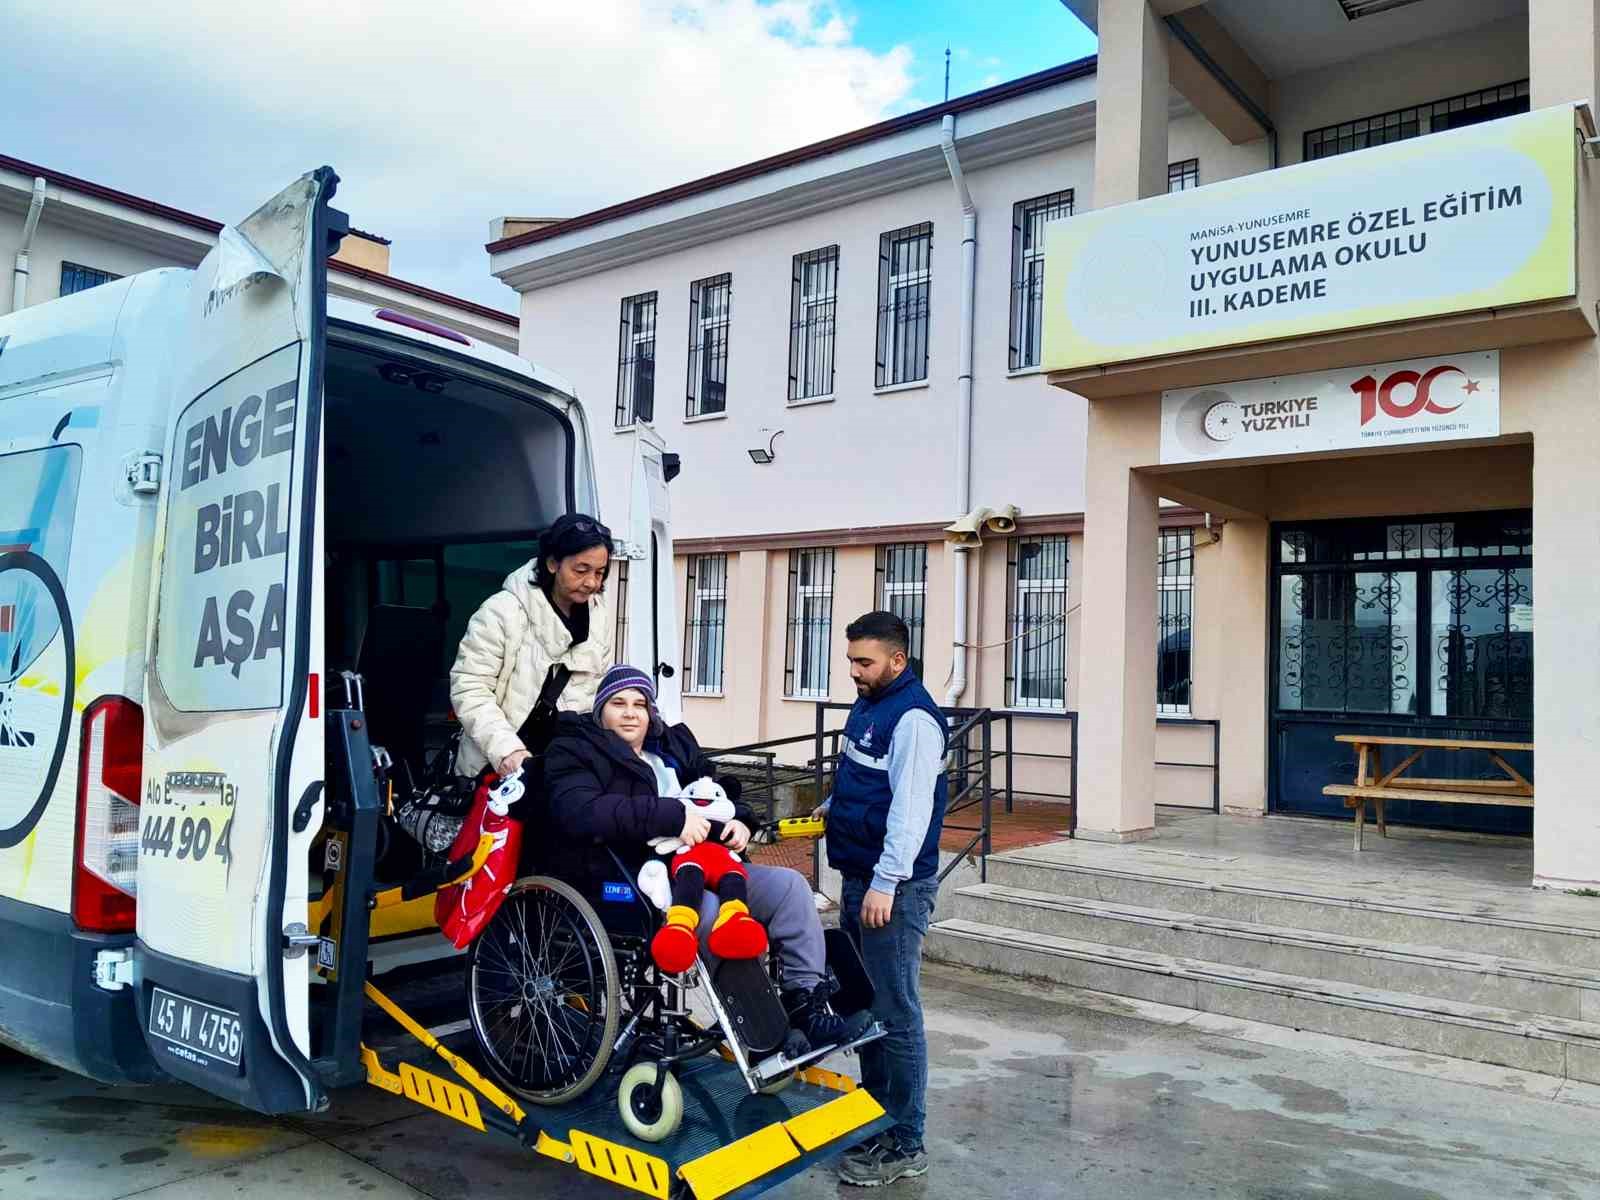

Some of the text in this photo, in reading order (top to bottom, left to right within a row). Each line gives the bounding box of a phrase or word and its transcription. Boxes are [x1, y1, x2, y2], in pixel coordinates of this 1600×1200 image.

[1191, 185, 1522, 265] YUNUSEMRE ÖZEL EĞİTİM
[1190, 232, 1426, 291] UYGULAMA OKULU
[1190, 278, 1326, 318] III. KADEME
[181, 379, 297, 491] ENGE
[193, 583, 284, 680] AŞA
[176, 816, 211, 861] 90
[157, 998, 176, 1033] 45
[199, 1011, 241, 1057] 4756
